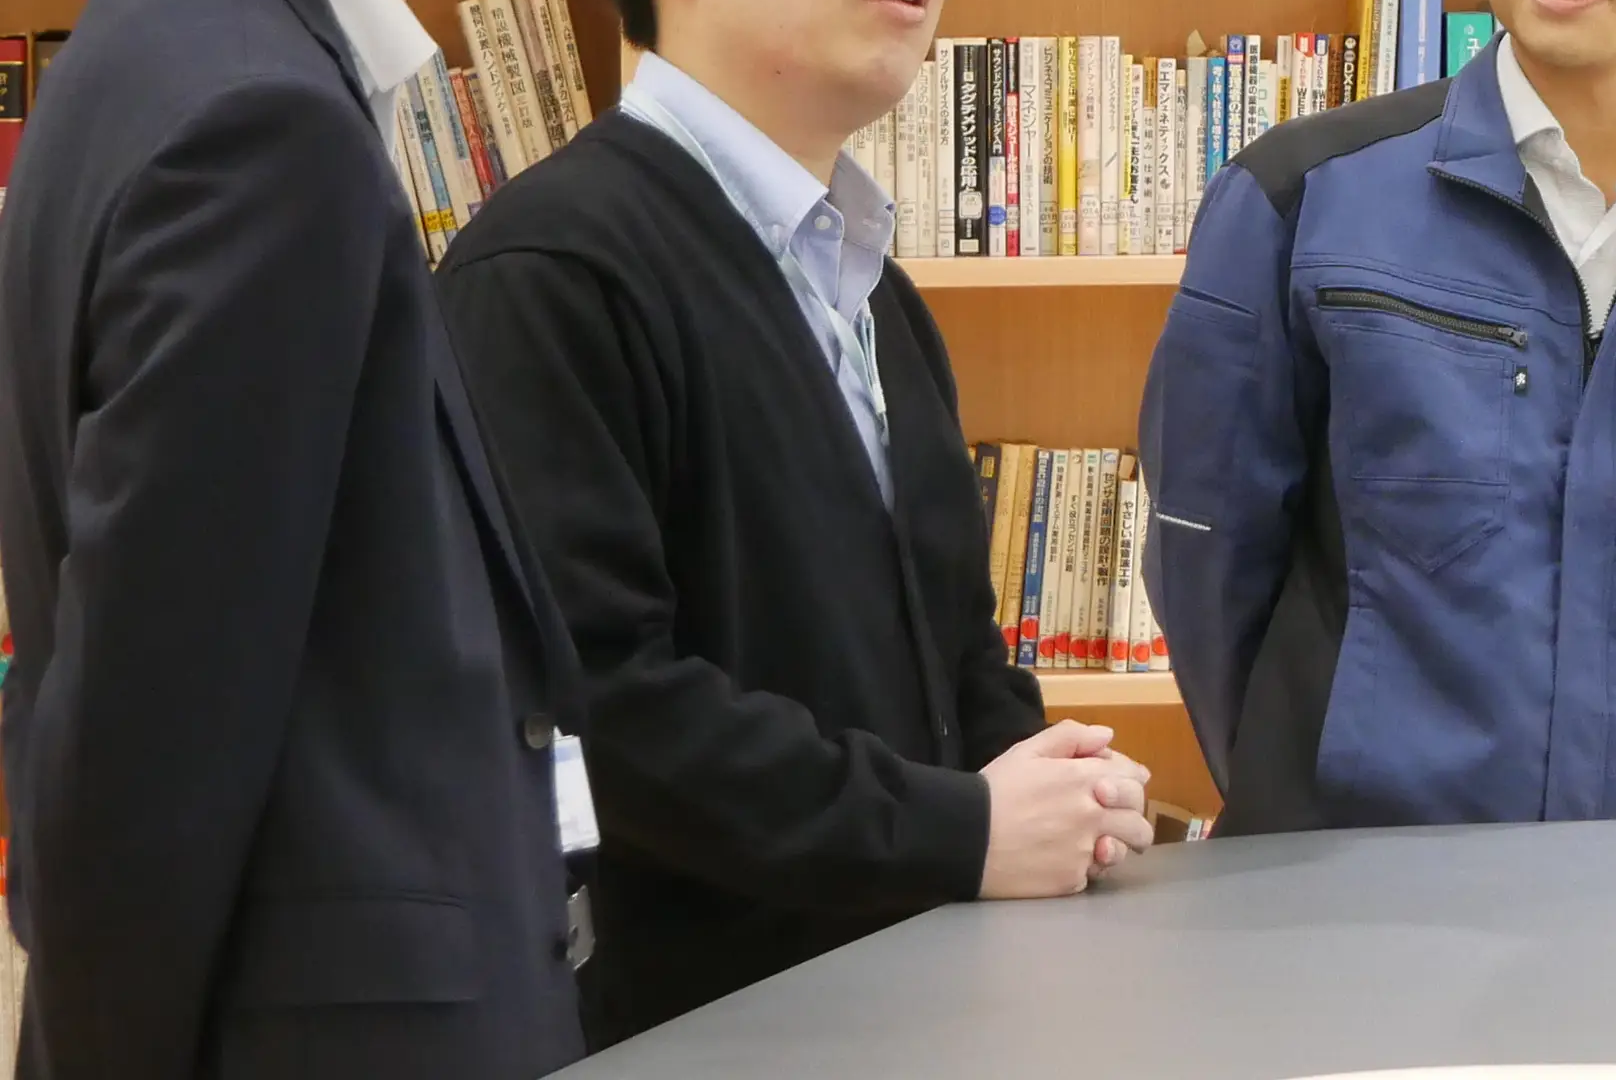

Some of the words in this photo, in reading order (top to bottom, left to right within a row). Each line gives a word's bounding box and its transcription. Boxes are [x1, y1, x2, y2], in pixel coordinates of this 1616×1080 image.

[939, 48, 949, 146] サンプルサイズの決め方
[1158, 71, 1171, 176] エマジェネティックス
